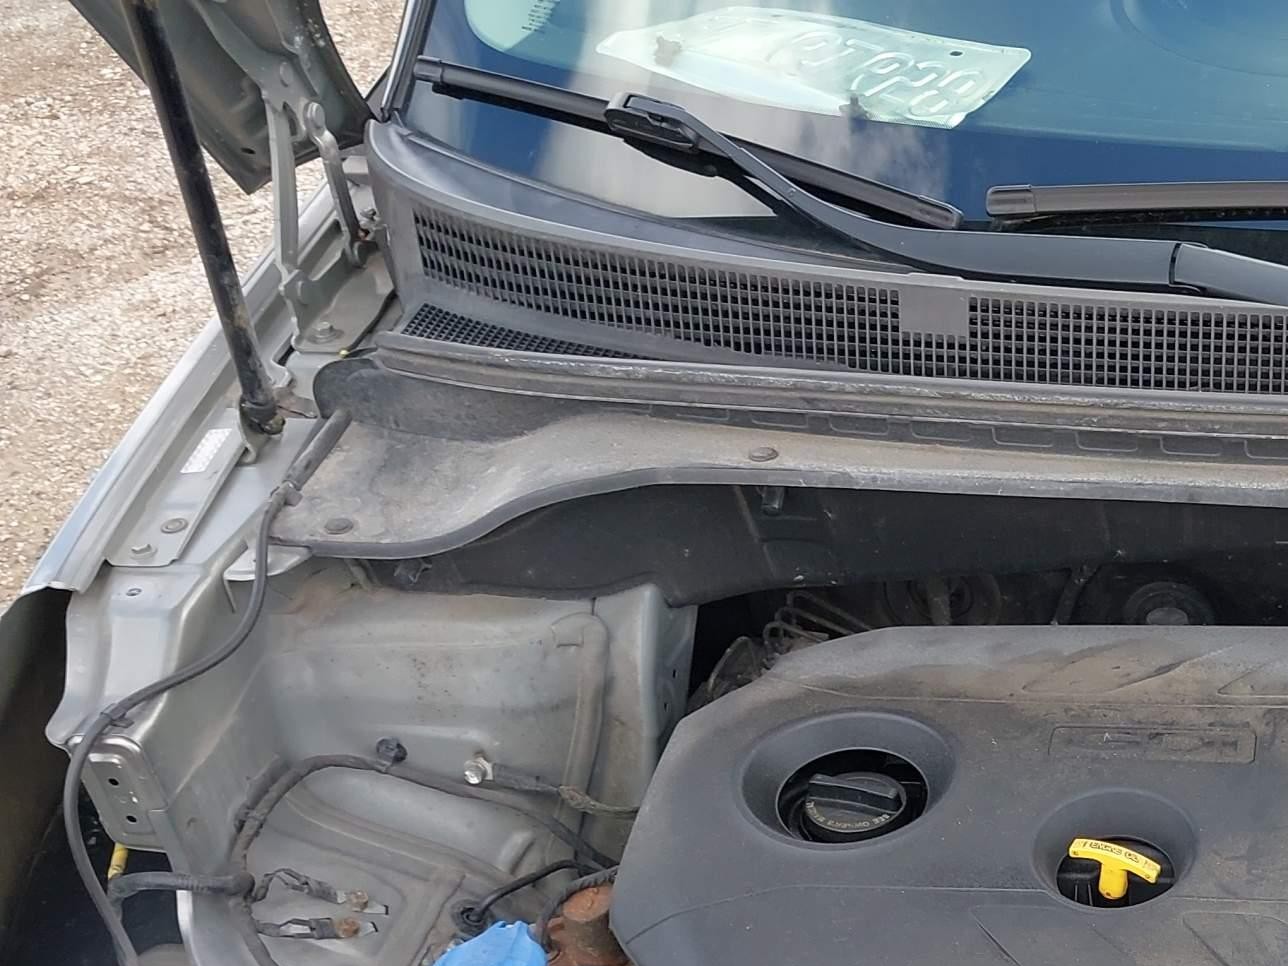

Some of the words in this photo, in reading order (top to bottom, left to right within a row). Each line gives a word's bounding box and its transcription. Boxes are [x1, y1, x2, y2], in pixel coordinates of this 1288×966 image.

[872, 813, 890, 825] SEE
[1089, 841, 1122, 856] ENGINE
[1124, 851, 1140, 863] OIL
